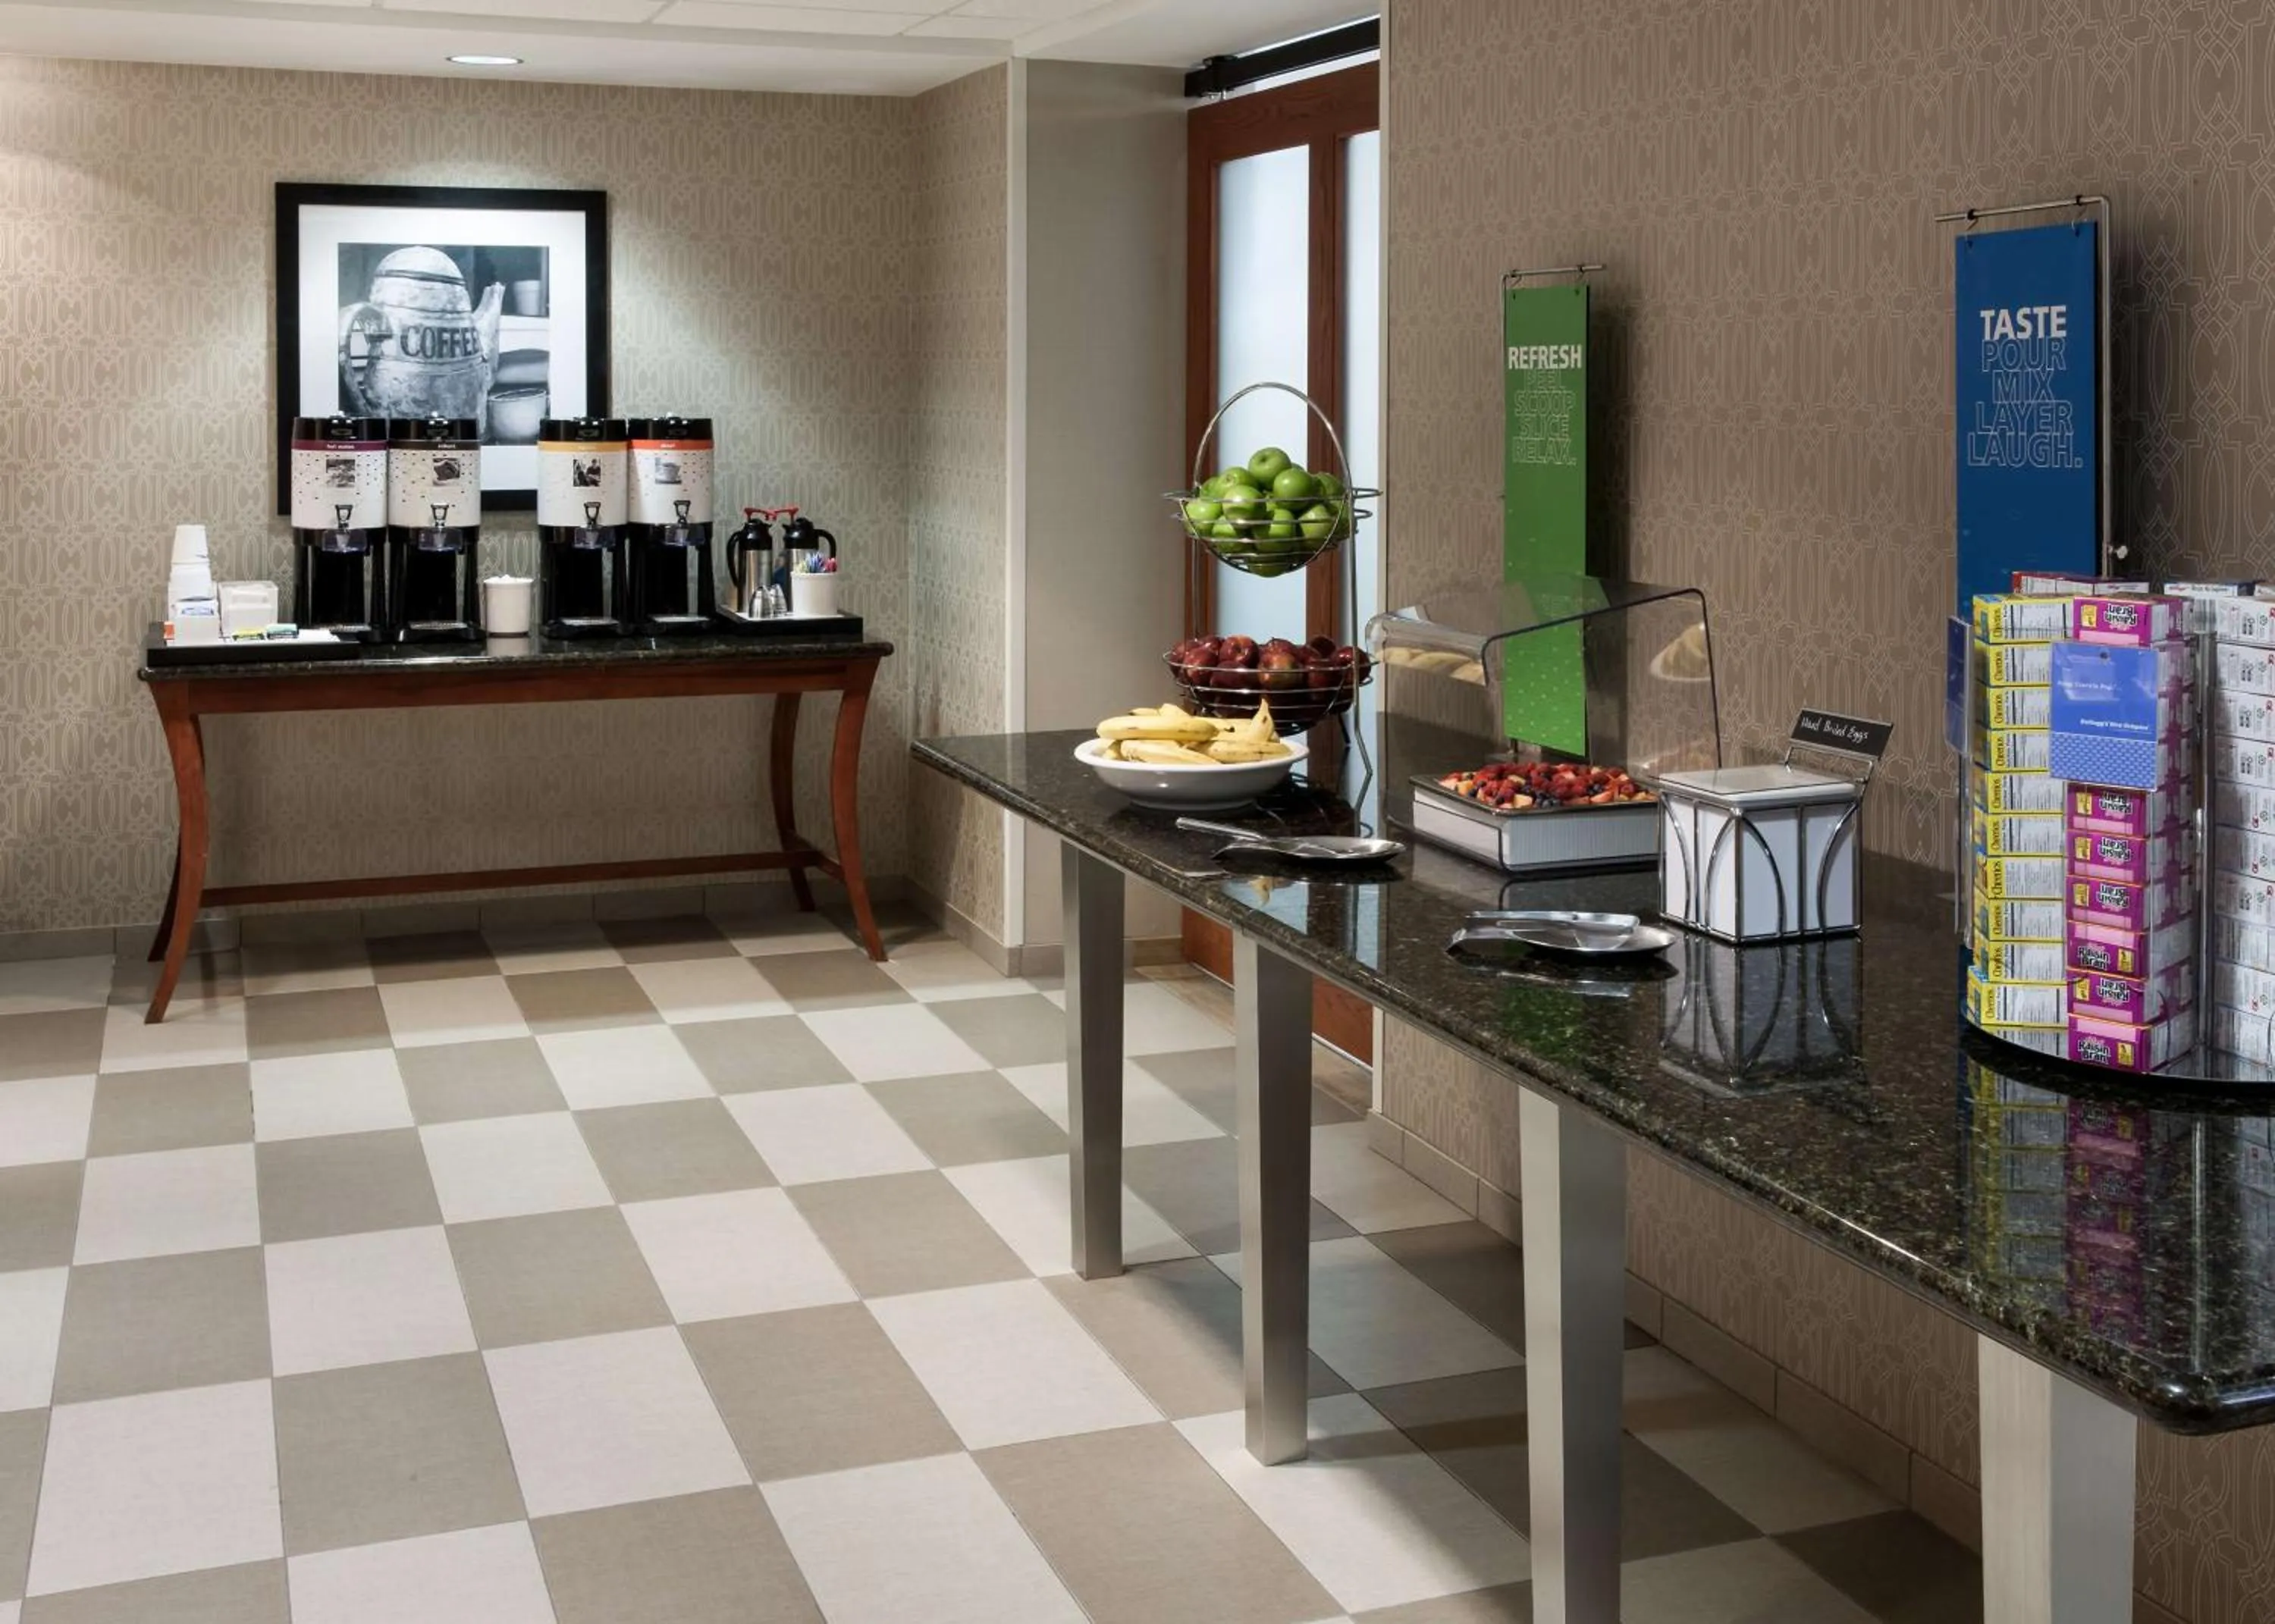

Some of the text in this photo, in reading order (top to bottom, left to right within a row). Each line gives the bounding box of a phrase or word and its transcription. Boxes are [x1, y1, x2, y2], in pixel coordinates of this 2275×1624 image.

[1979, 305, 2067, 340] TASTE
[400, 325, 481, 358] COFFEE
[1508, 344, 1582, 369] REFRESH
[1982, 337, 2067, 372] POUR
[1991, 368, 2055, 403] MIX
[1514, 390, 1576, 417] SCOOP
[1975, 400, 2074, 435] LAYER
[1967, 431, 2083, 468] LAUGH.
[1847, 726, 1869, 744] Eggs
[2078, 1040, 2110, 1057] Raisin
[2081, 1049, 2109, 1064] Bran
